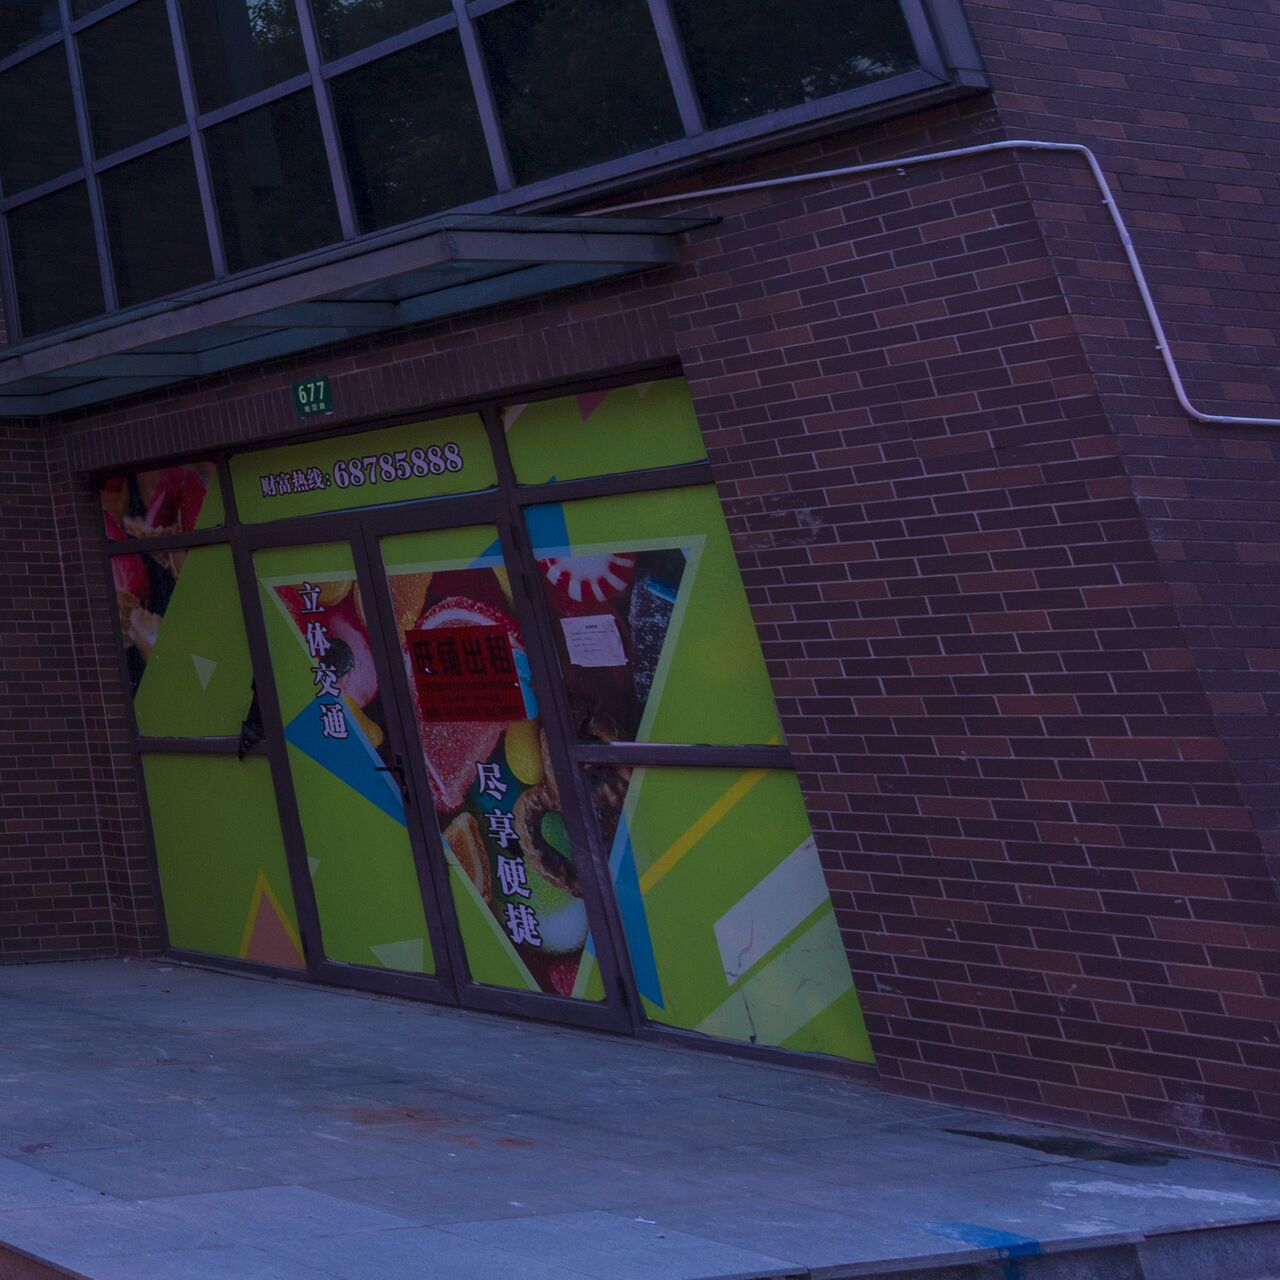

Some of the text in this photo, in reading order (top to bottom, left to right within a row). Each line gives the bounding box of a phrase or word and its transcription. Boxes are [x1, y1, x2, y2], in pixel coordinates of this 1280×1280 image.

[298, 380, 325, 404] 677
[297, 581, 349, 740] 立体交通
[412, 633, 515, 676] 旺铺出租
[476, 761, 542, 947] 尽享便捷
